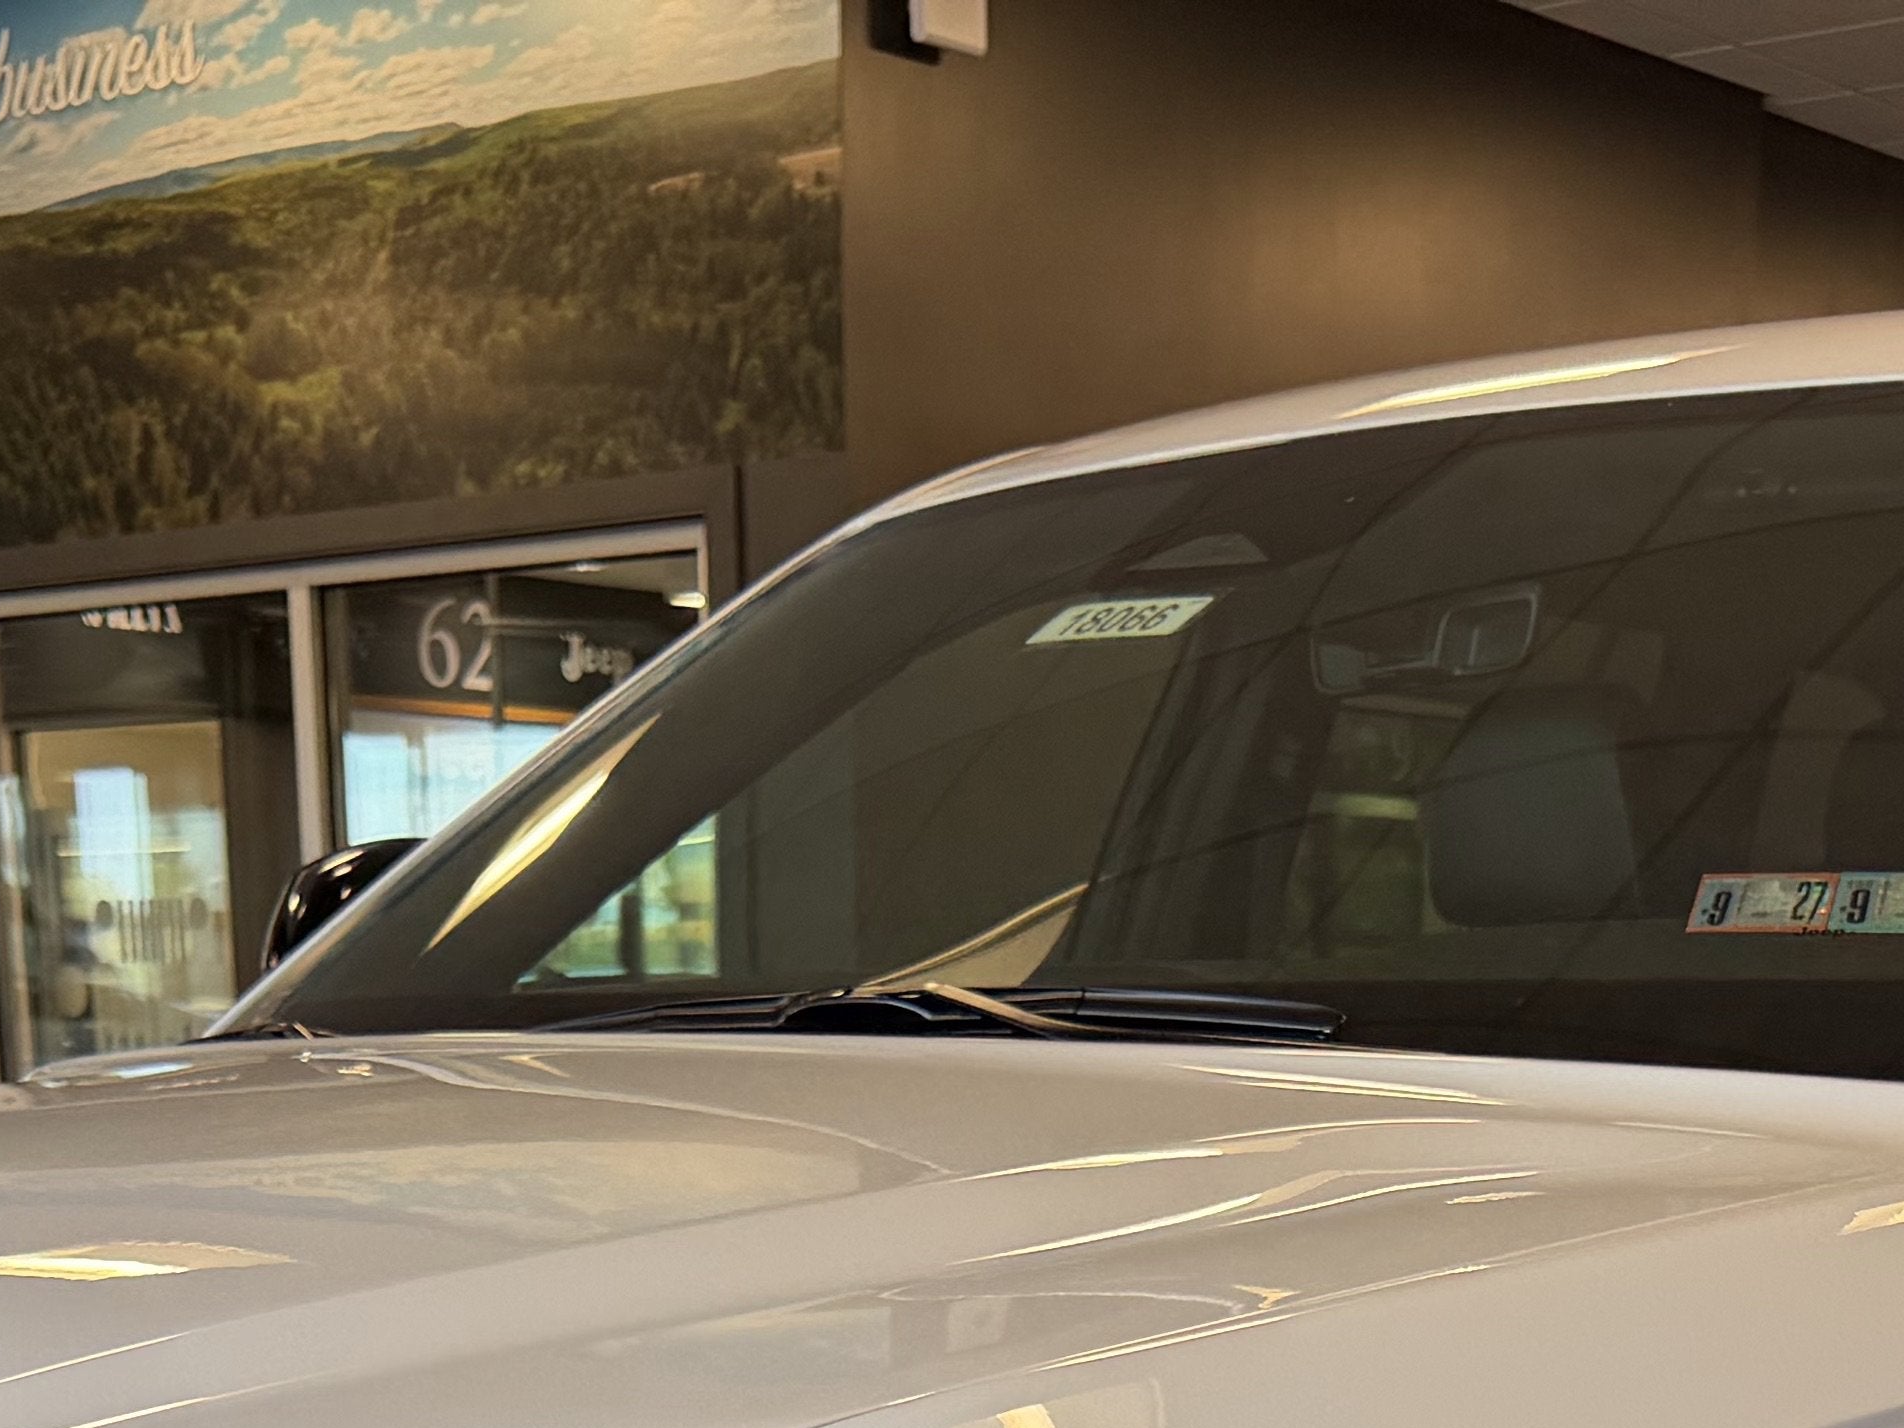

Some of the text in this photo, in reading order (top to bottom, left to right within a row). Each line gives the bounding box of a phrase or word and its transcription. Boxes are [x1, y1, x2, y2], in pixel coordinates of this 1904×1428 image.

[1059, 604, 1180, 636] 18066
[419, 599, 493, 692] 62
[1706, 881, 1828, 925] 9 27
[1846, 888, 1871, 924] 9
